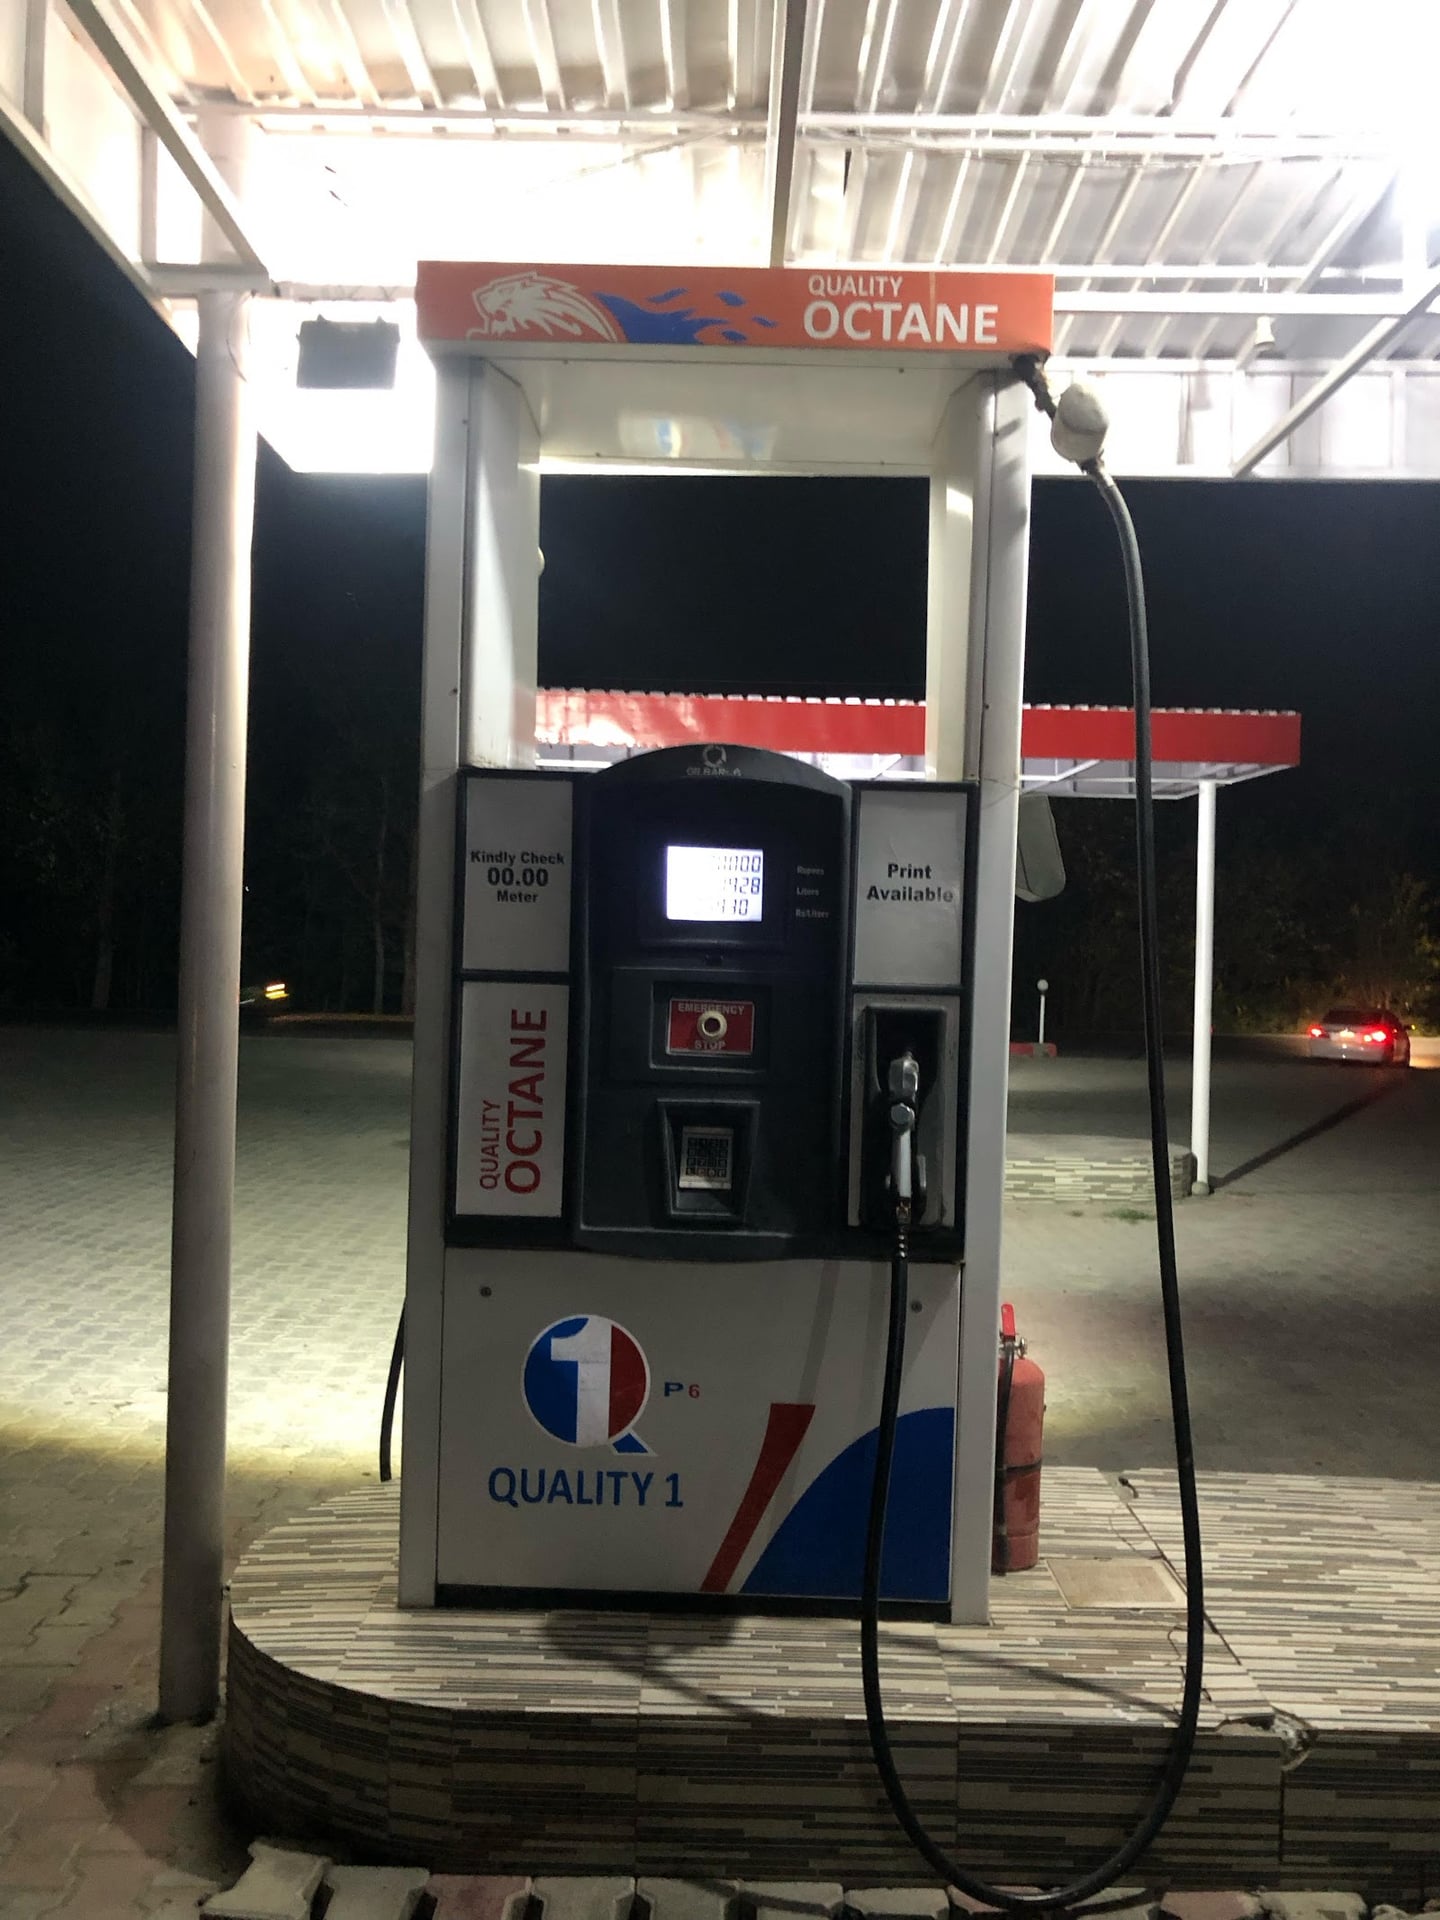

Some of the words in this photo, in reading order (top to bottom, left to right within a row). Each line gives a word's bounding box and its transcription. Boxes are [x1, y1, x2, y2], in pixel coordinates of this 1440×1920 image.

[808, 275, 903, 297] QUALITY
[803, 301, 999, 344] OCTANE
[470, 851, 516, 866] Kindly
[521, 852, 565, 864] Check
[487, 867, 549, 887] 00.00
[888, 863, 932, 879] Print
[497, 890, 539, 903] Meter
[866, 885, 954, 903] Available
[678, 1003, 745, 1016] EMERGENCY
[694, 1040, 726, 1051] STOP
[504, 1009, 548, 1194] OCTANE
[480, 1100, 501, 1190] QUALITY
[488, 1466, 654, 1508] QUALITY
[665, 1473, 684, 1508] 1
